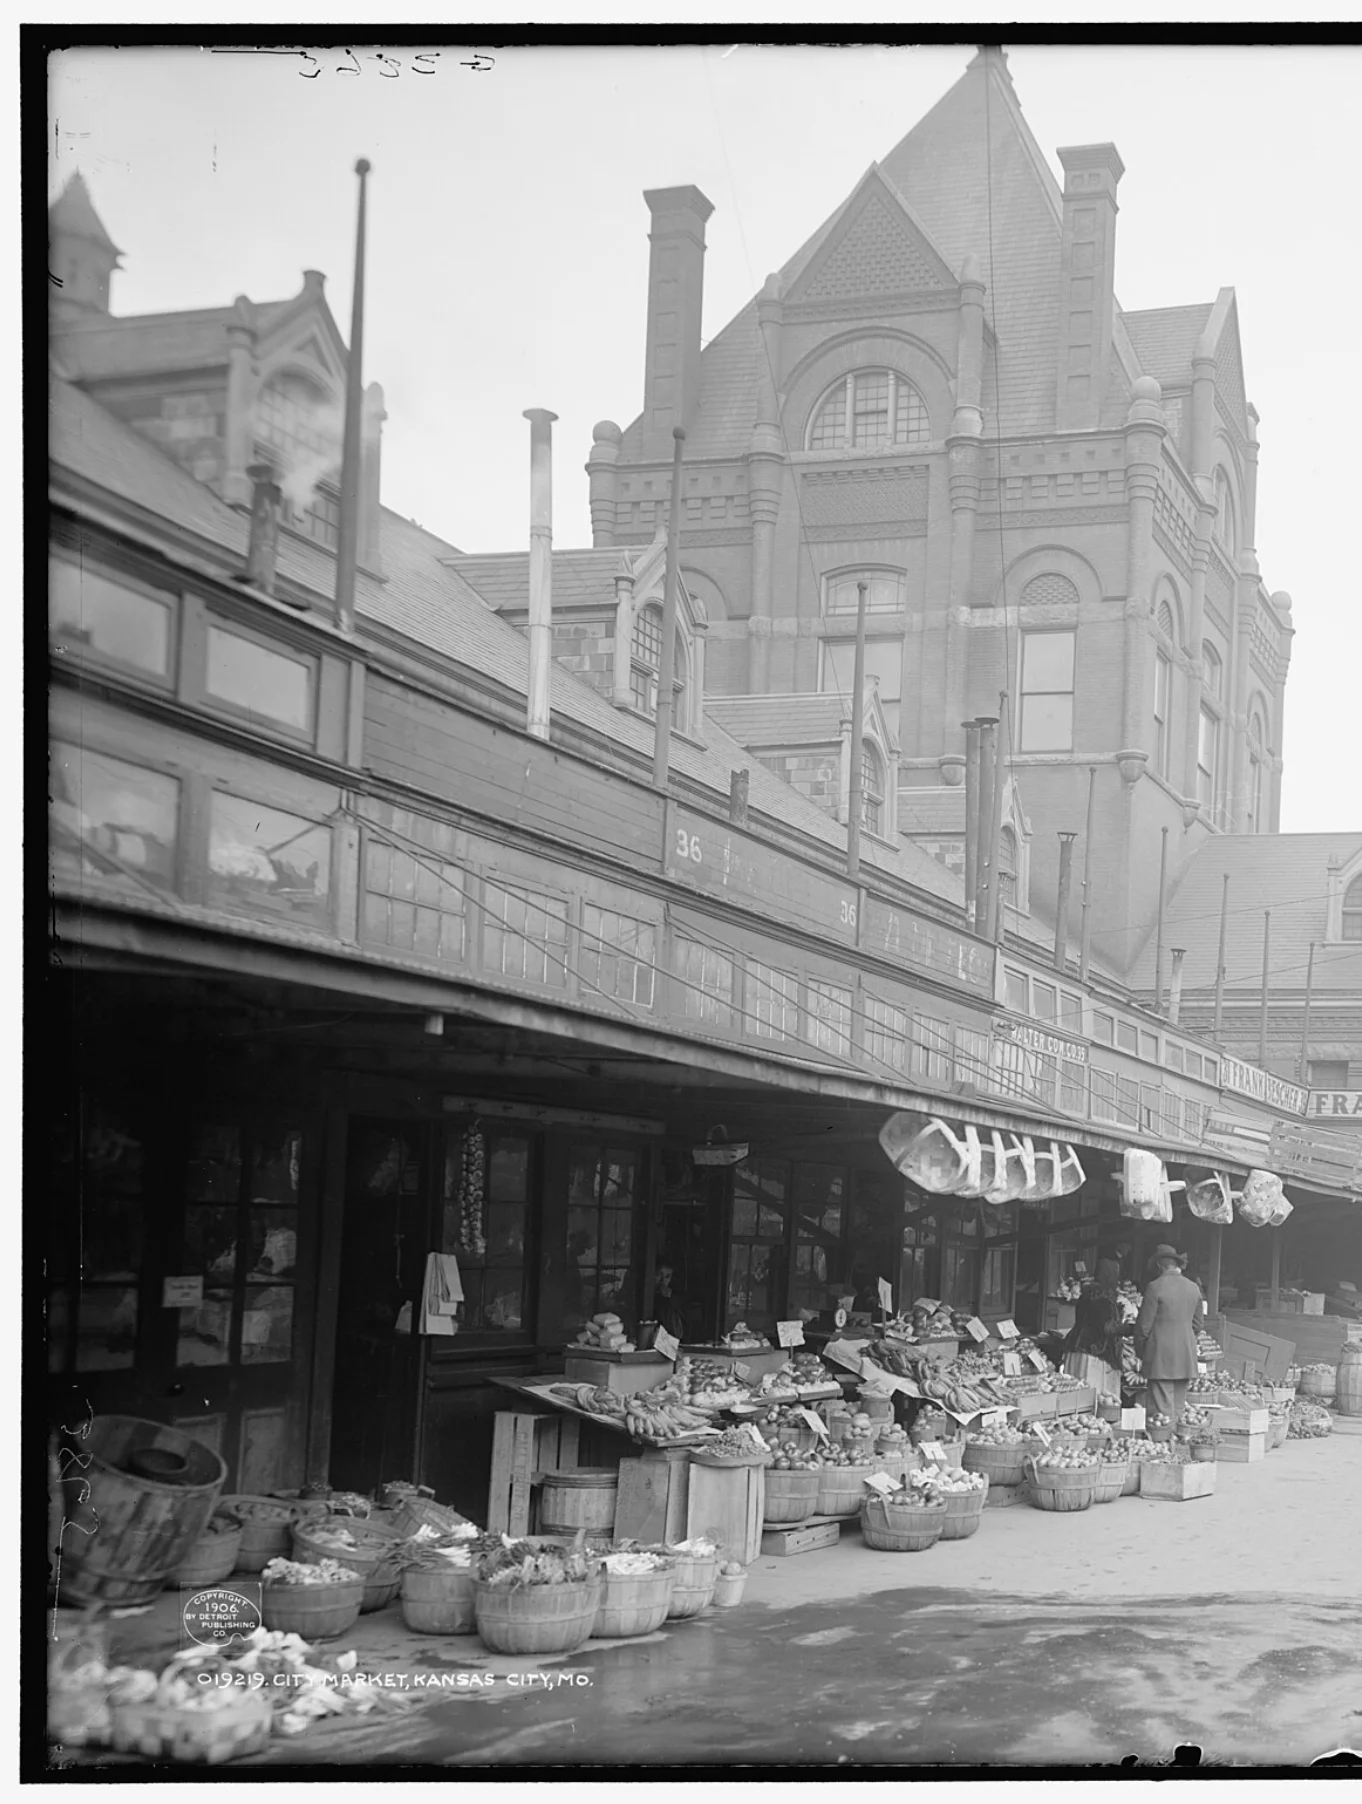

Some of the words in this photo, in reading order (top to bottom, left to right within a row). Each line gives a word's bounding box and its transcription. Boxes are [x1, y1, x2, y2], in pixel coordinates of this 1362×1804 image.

[675, 829, 702, 863] 36
[840, 900, 857, 927] 36
[1233, 1063, 1264, 1099] FRANK
[1267, 1077, 1298, 1112] BESCHER
